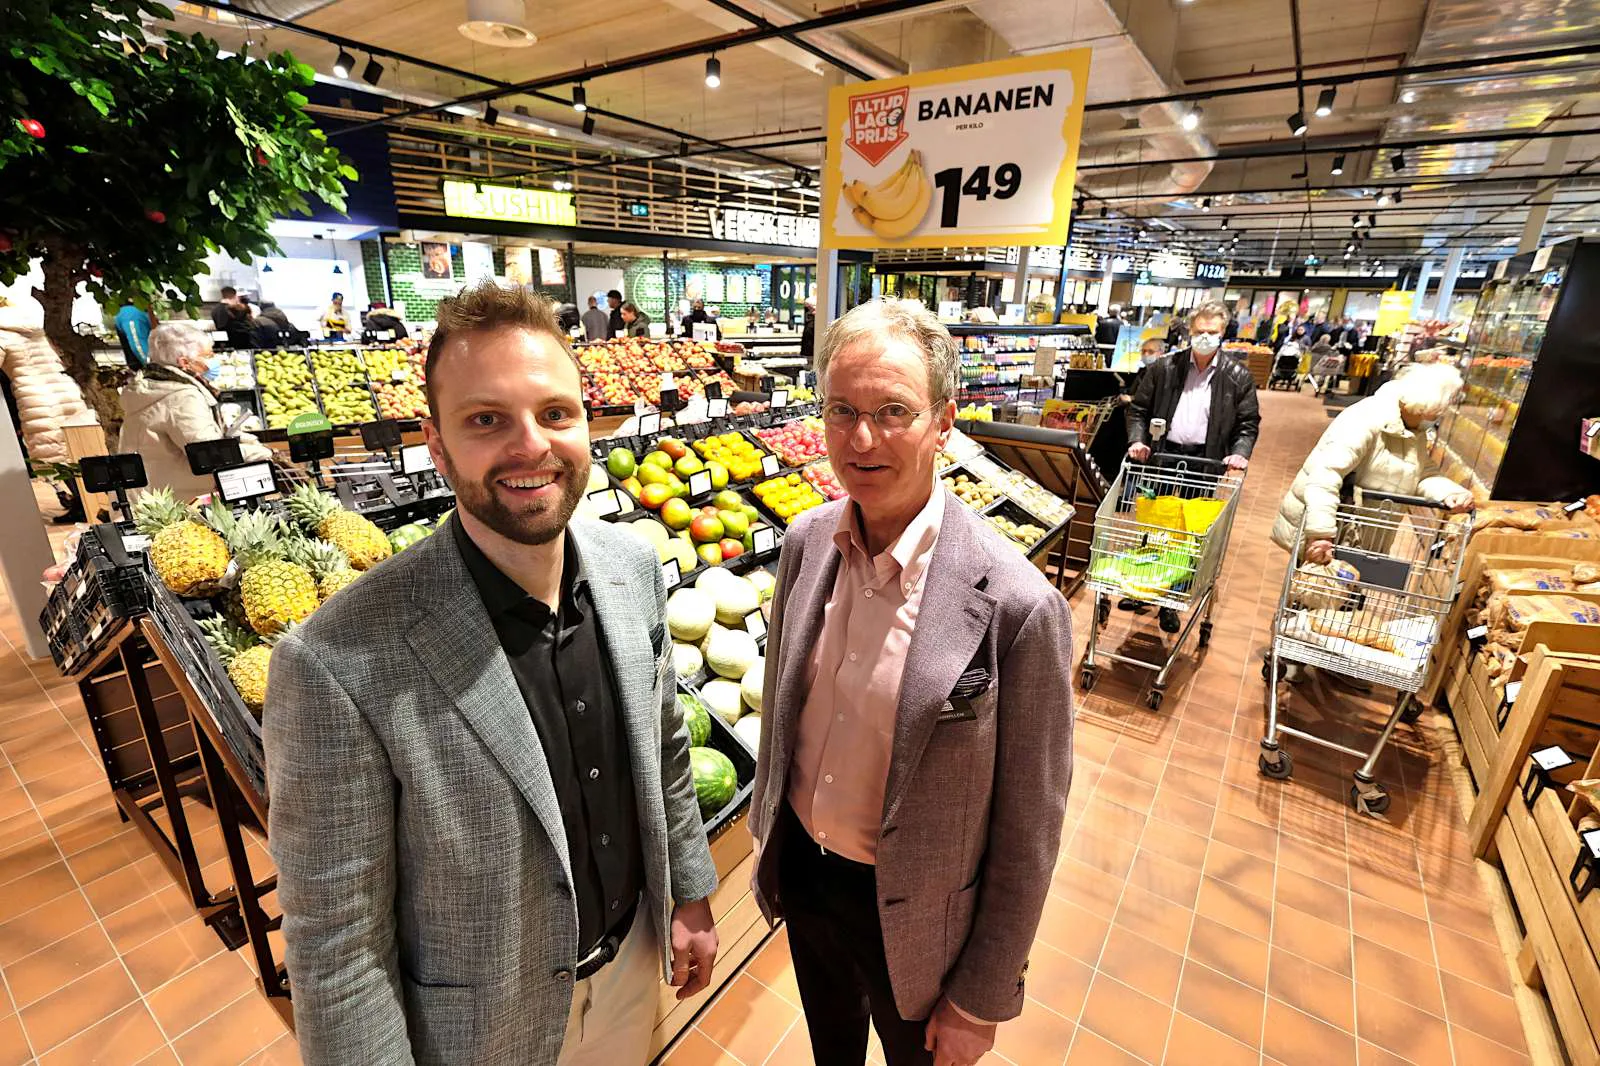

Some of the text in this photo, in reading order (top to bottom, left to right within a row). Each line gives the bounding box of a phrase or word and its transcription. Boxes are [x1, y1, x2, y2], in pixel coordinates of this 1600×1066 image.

[854, 95, 904, 113] ALTIJD
[918, 84, 1055, 121] BANANEN
[955, 122, 984, 131] PER KILO
[855, 127, 898, 145] PRIJS
[474, 191, 551, 223] SUSHI
[1197, 263, 1225, 280] PIZZA
